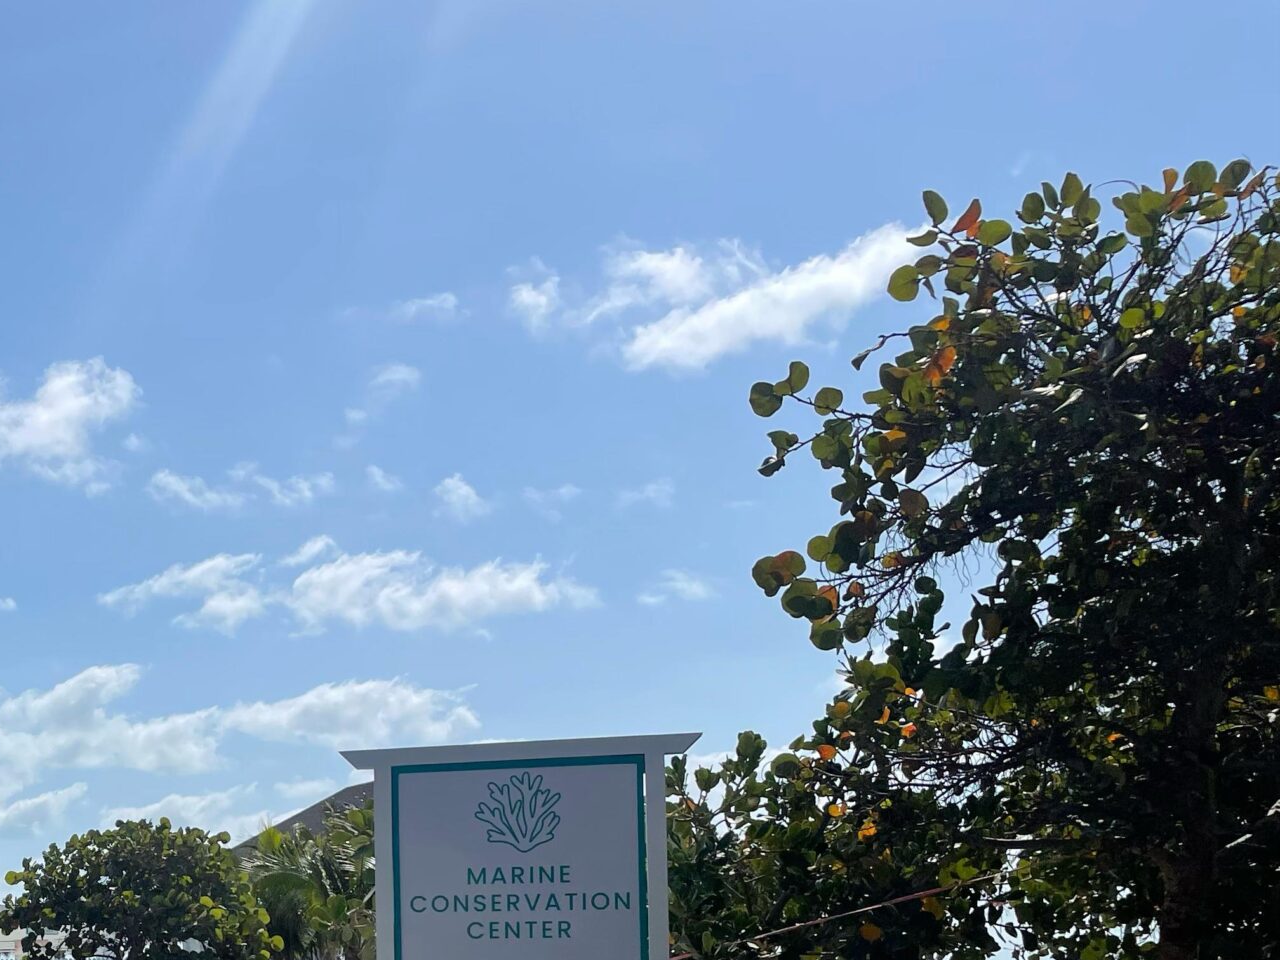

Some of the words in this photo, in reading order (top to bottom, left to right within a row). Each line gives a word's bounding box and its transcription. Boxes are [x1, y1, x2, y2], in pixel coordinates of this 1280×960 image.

[467, 865, 570, 885] MARINE
[410, 892, 631, 913] CONSERVATION
[467, 921, 571, 940] CENTER
